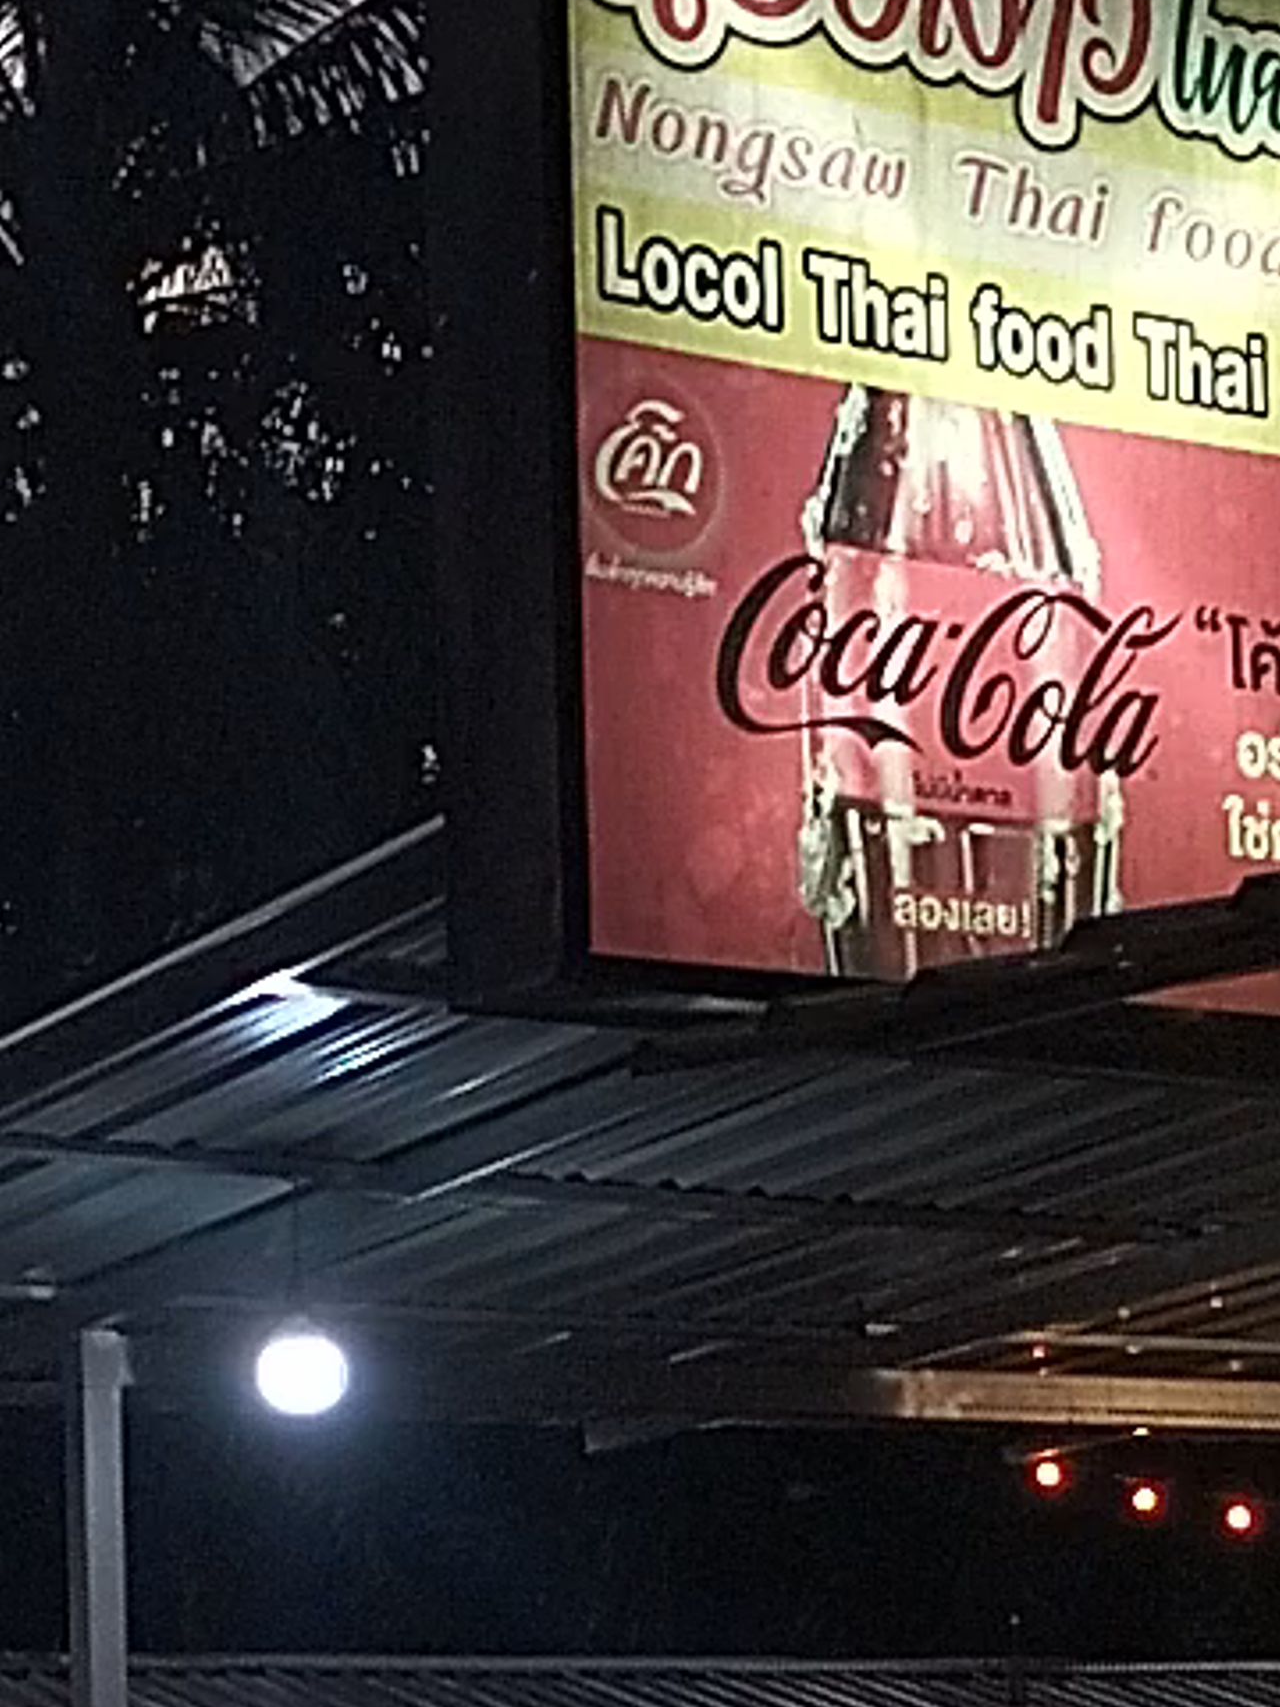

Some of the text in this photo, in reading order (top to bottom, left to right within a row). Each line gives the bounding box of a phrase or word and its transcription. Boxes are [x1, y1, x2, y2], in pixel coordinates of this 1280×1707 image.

[596, 79, 907, 201] Nongsaw
[957, 155, 1109, 242] Thai
[596, 205, 784, 333] Locol
[803, 247, 949, 360] Thai
[971, 282, 1113, 389] food
[1133, 310, 1269, 417] Thai
[716, 554, 1182, 779] Coca-Cola
[893, 892, 1031, 939] ลองเลย!
